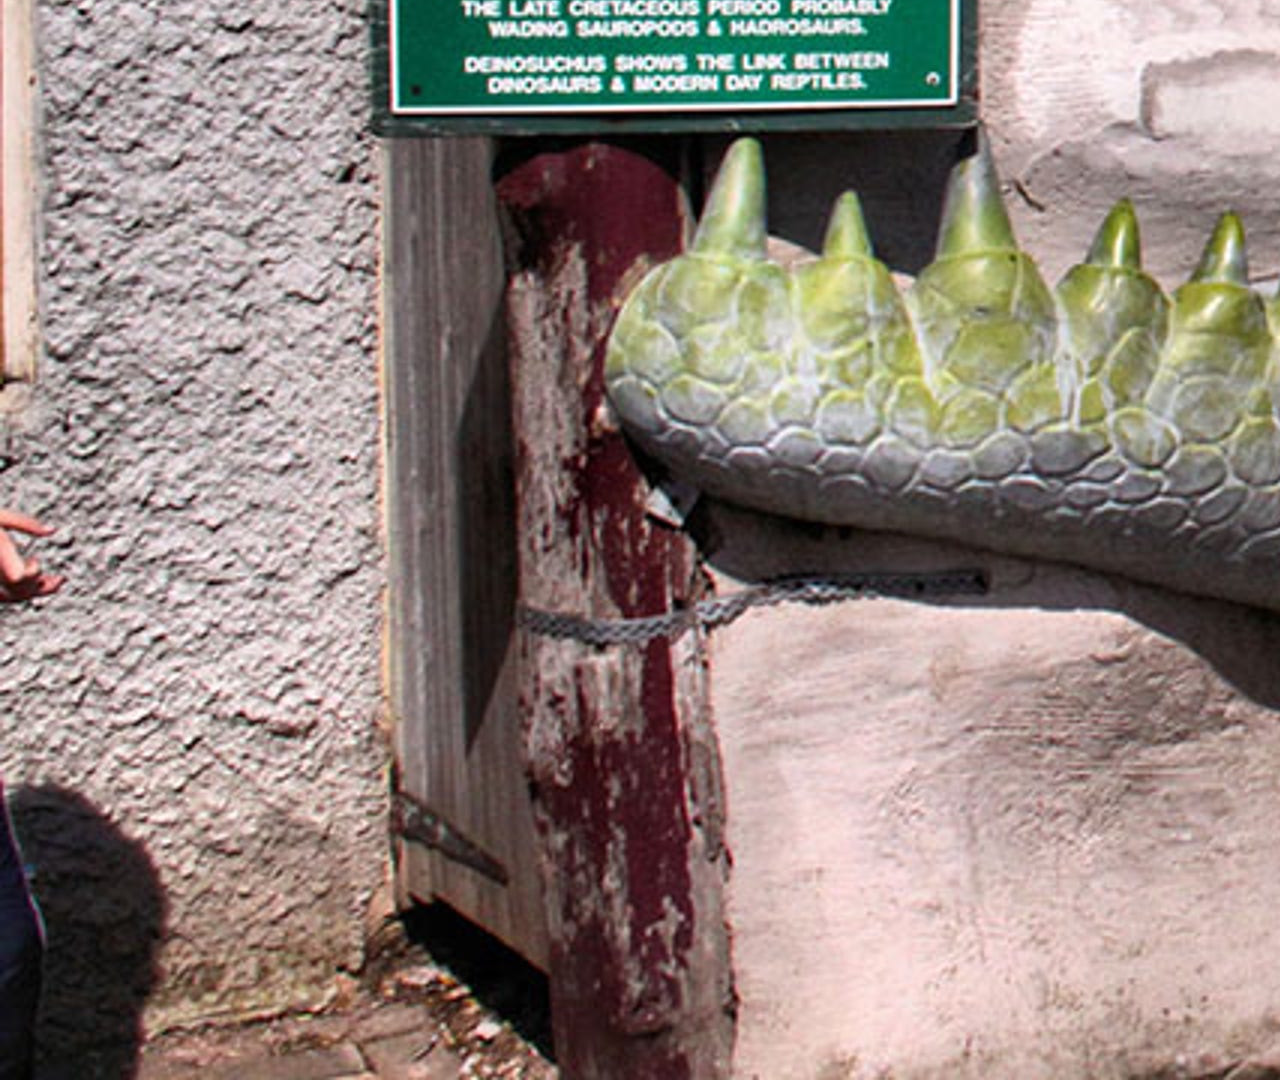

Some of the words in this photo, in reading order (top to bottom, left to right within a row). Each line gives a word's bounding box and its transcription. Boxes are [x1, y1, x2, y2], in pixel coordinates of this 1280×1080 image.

[462, 0, 500, 17] THE
[509, 0, 559, 17] LATE
[568, 0, 699, 16] CRETACEOUS
[707, 0, 780, 15] PERIOD
[488, 21, 568, 38] WADING
[576, 20, 698, 37] SAUROPODS
[707, 20, 720, 36] &
[730, 18, 866, 36] HADROSAURS.
[464, 56, 606, 73] DEINOSUCHUS
[615, 55, 687, 72] SHOWS
[696, 54, 733, 71] THE
[742, 54, 785, 71] LINK
[794, 52, 888, 69] BETWEEN
[488, 76, 601, 94] DINOSAURS
[610, 77, 624, 93] &
[633, 75, 718, 93] MODERN
[725, 75, 762, 91] DAY
[771, 73, 865, 90] REPTILES.
